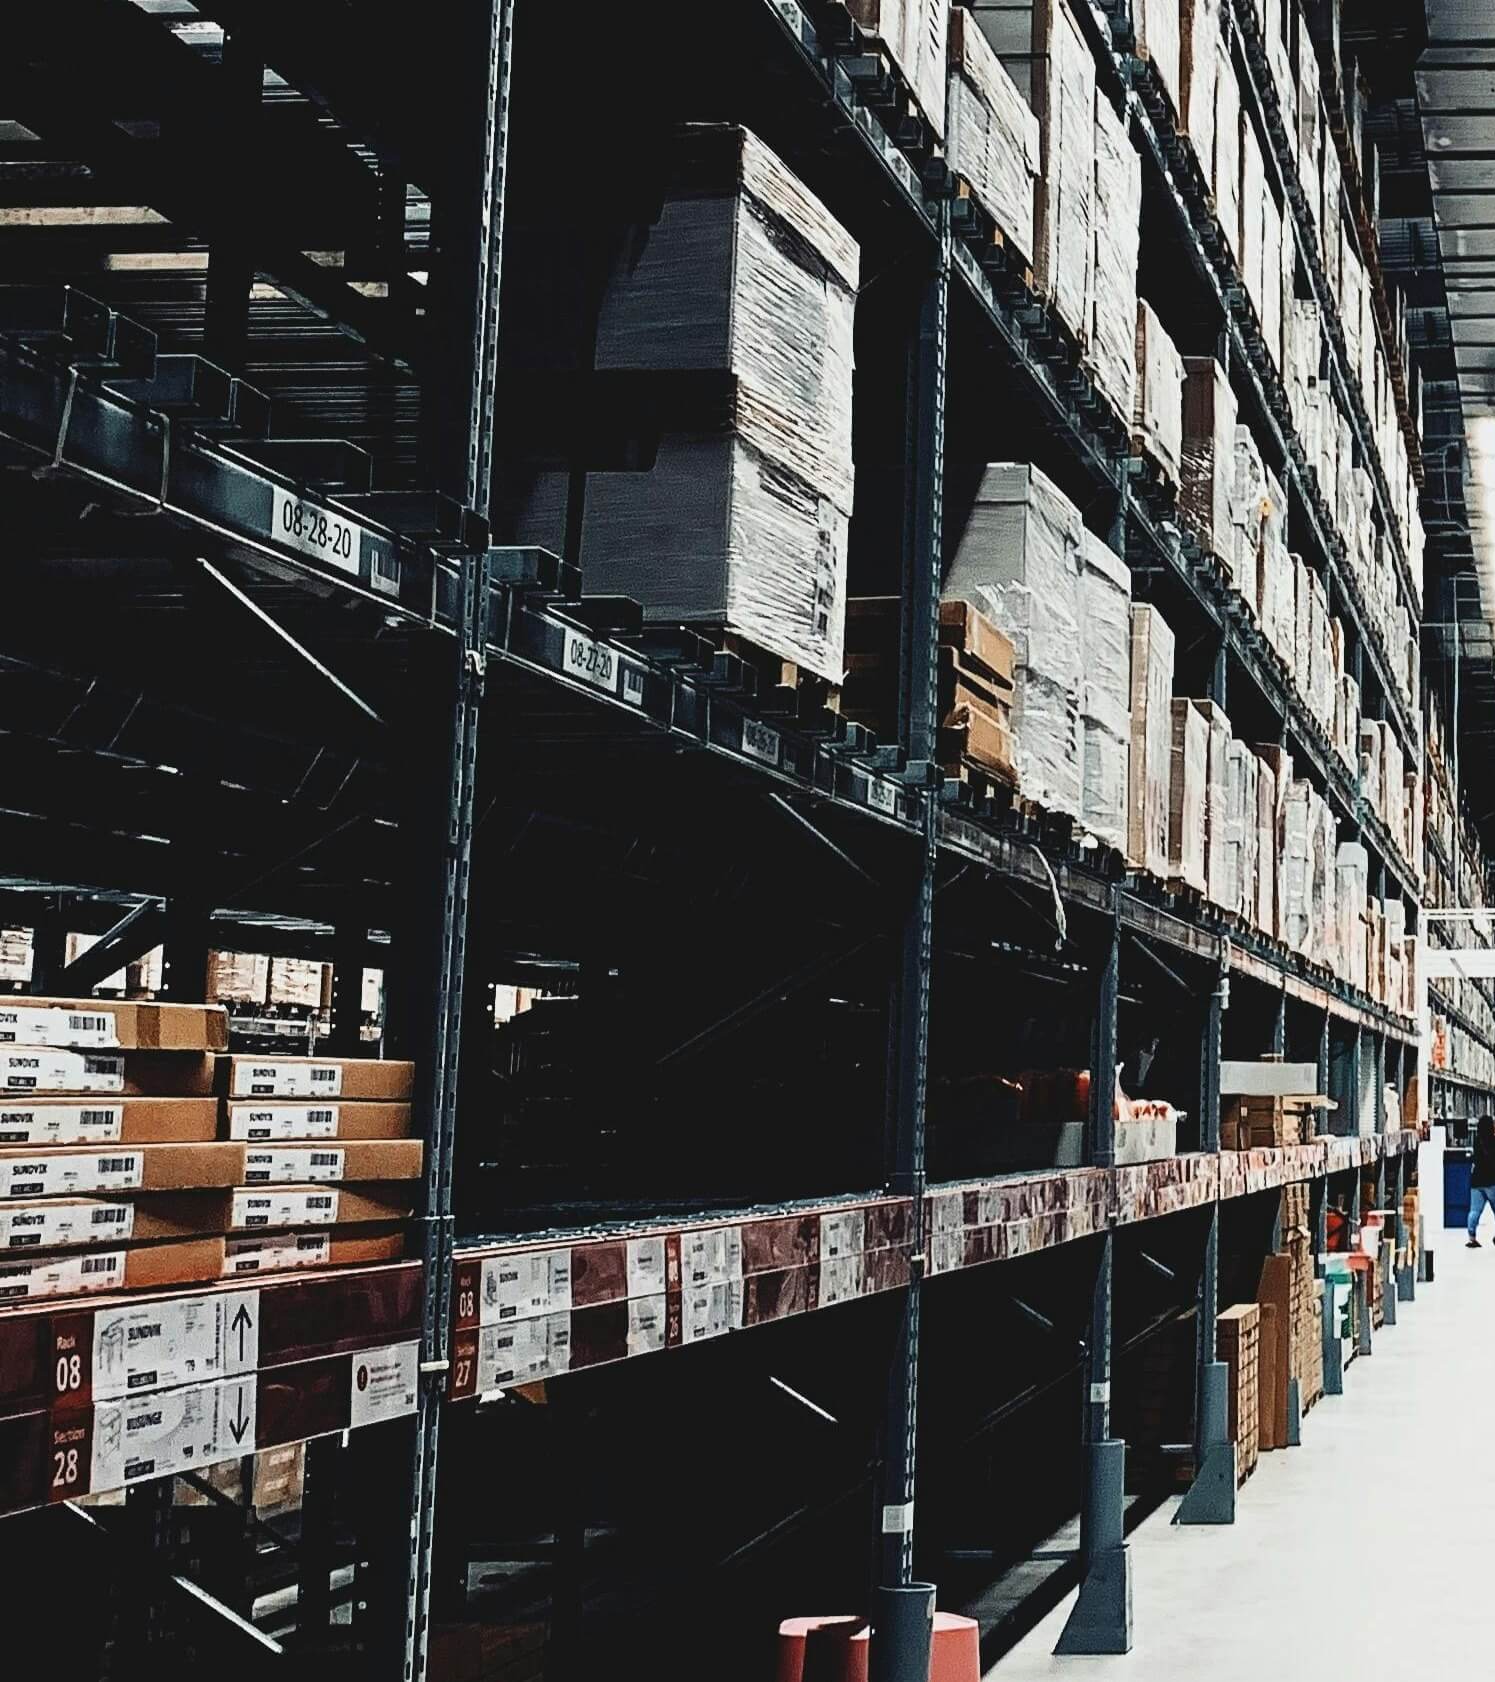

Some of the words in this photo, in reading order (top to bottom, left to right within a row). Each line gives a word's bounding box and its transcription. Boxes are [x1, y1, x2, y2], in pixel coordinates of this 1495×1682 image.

[283, 499, 352, 559] 08-28-20
[571, 638, 612, 681] 08-27-20
[459, 1291, 474, 1319] 08
[56, 1354, 82, 1392] 08
[455, 1359, 472, 1388] 27
[53, 1448, 79, 1487] 28
